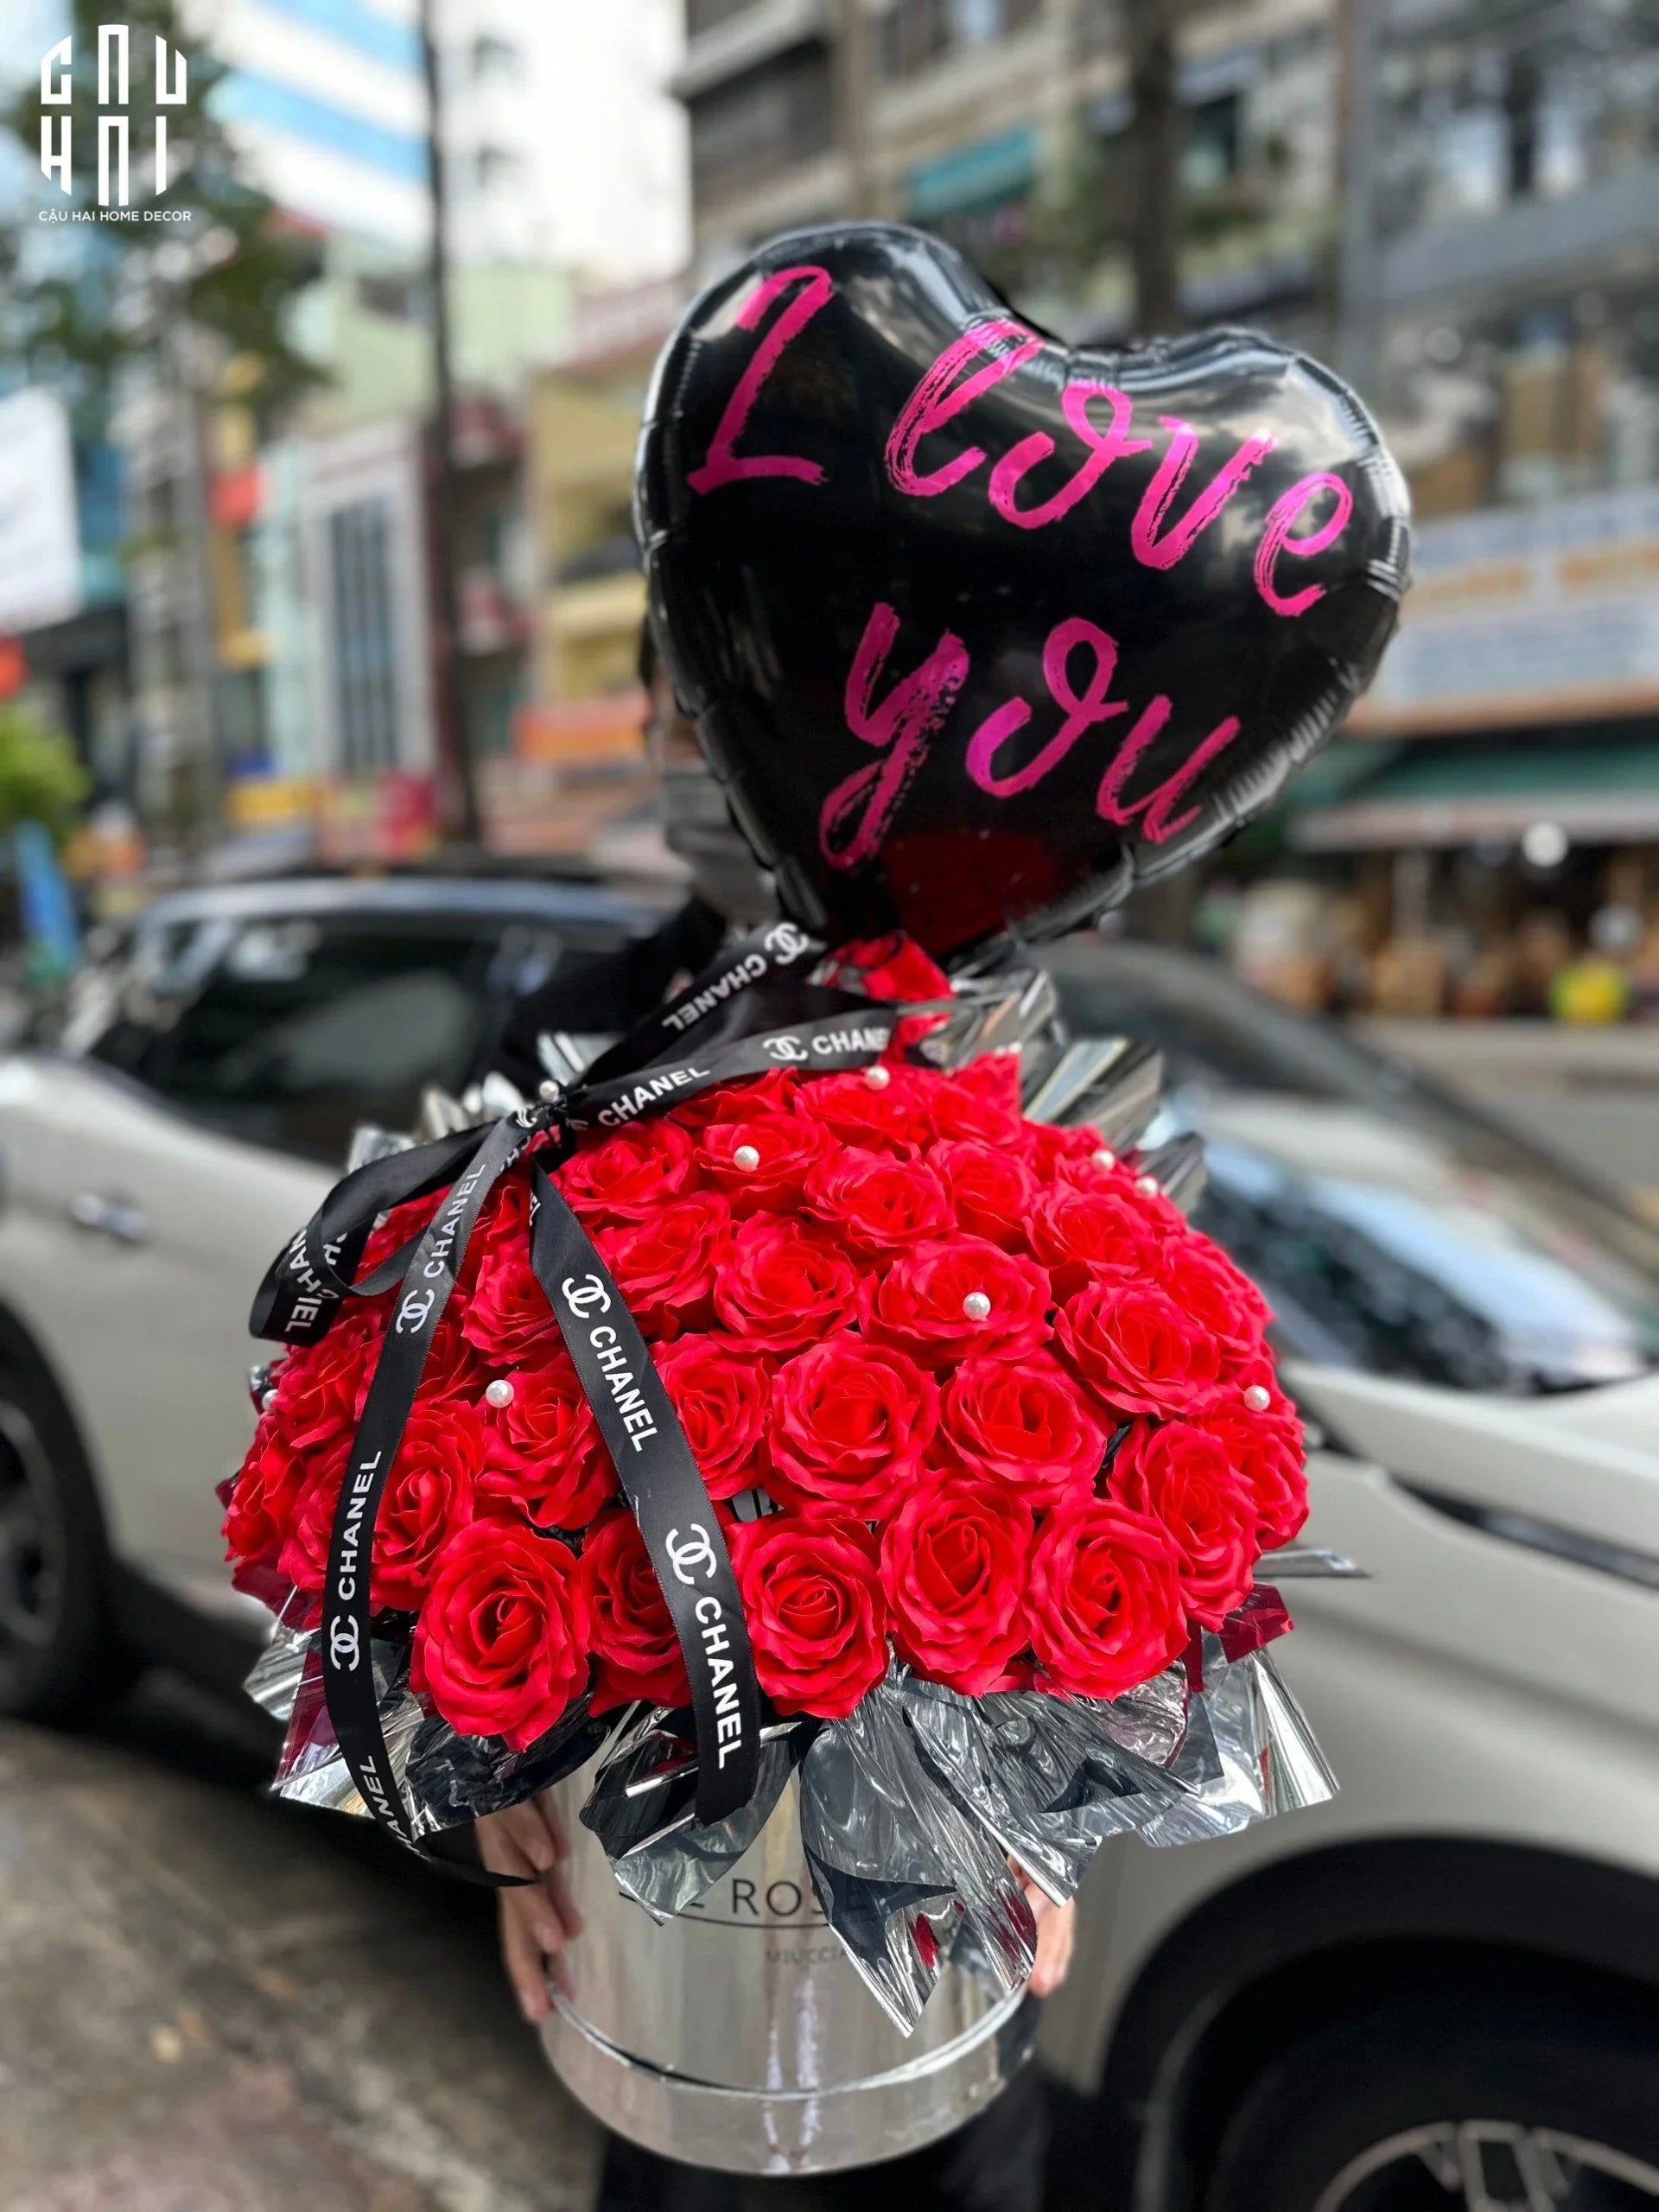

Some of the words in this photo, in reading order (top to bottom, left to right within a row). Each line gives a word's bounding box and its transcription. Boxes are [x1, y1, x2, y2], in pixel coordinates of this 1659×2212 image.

[662, 953, 767, 1031] CHANEL
[598, 1067, 710, 1127] CHANEL
[423, 1164, 486, 1278] CHANEL
[589, 1325, 659, 1453] CHANEL
[338, 1451, 382, 1600] CHANEL
[695, 1596, 741, 1770] CHANEL
